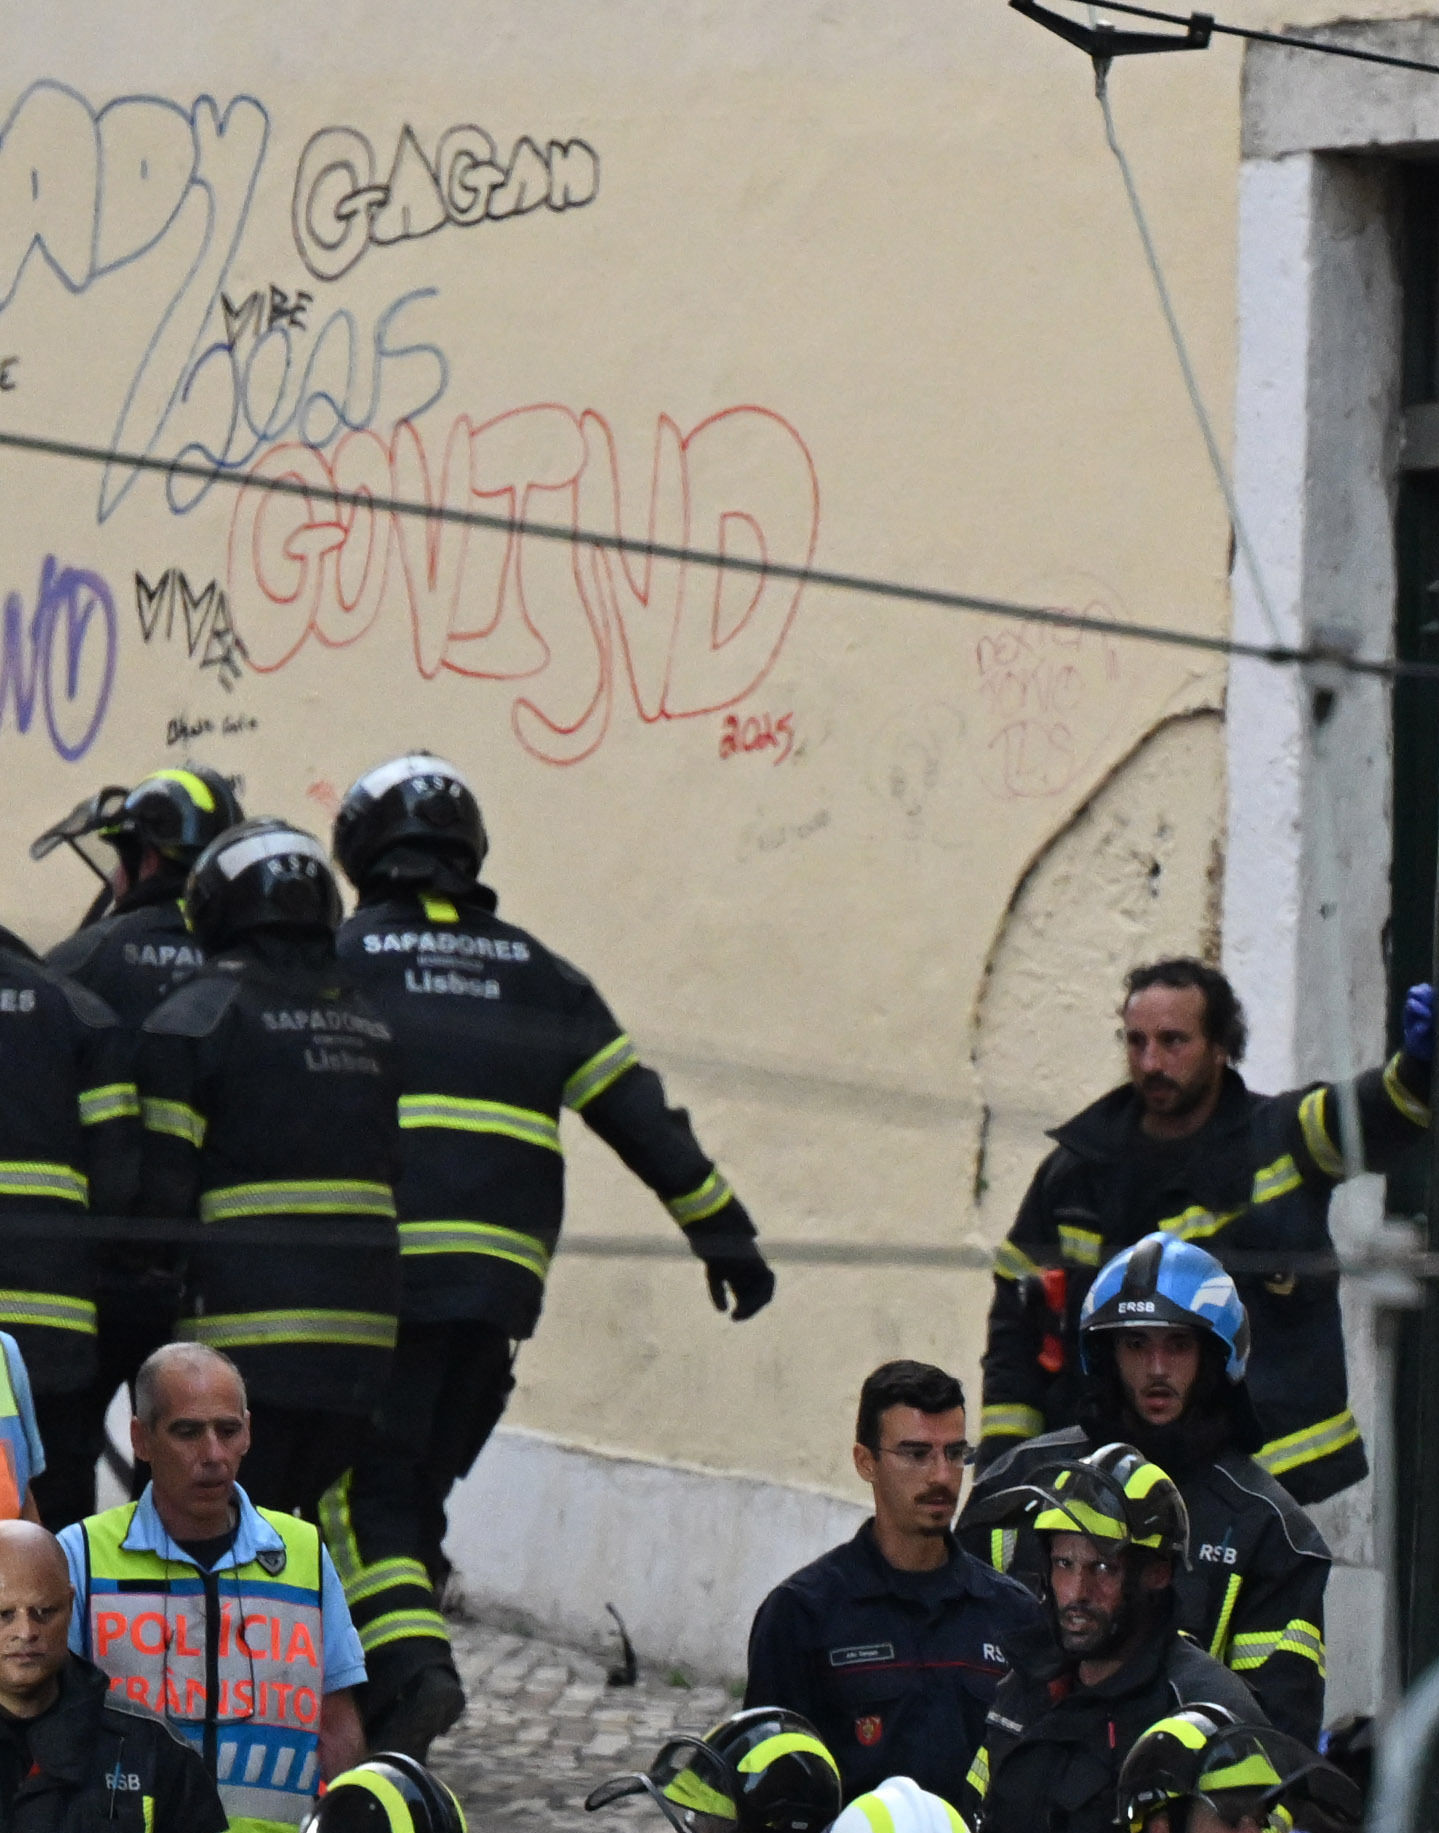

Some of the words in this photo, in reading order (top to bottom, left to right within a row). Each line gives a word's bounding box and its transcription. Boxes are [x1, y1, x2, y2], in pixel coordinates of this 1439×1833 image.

[363, 931, 531, 962] SAPADORES
[404, 967, 501, 1000] Lisboa
[1118, 1301, 1155, 1314] ERSB
[1199, 1543, 1238, 1565] RSB
[96, 1602, 318, 1668] POLÍCIA
[982, 1643, 1007, 1663] RS
[105, 1772, 141, 1791] RSB
